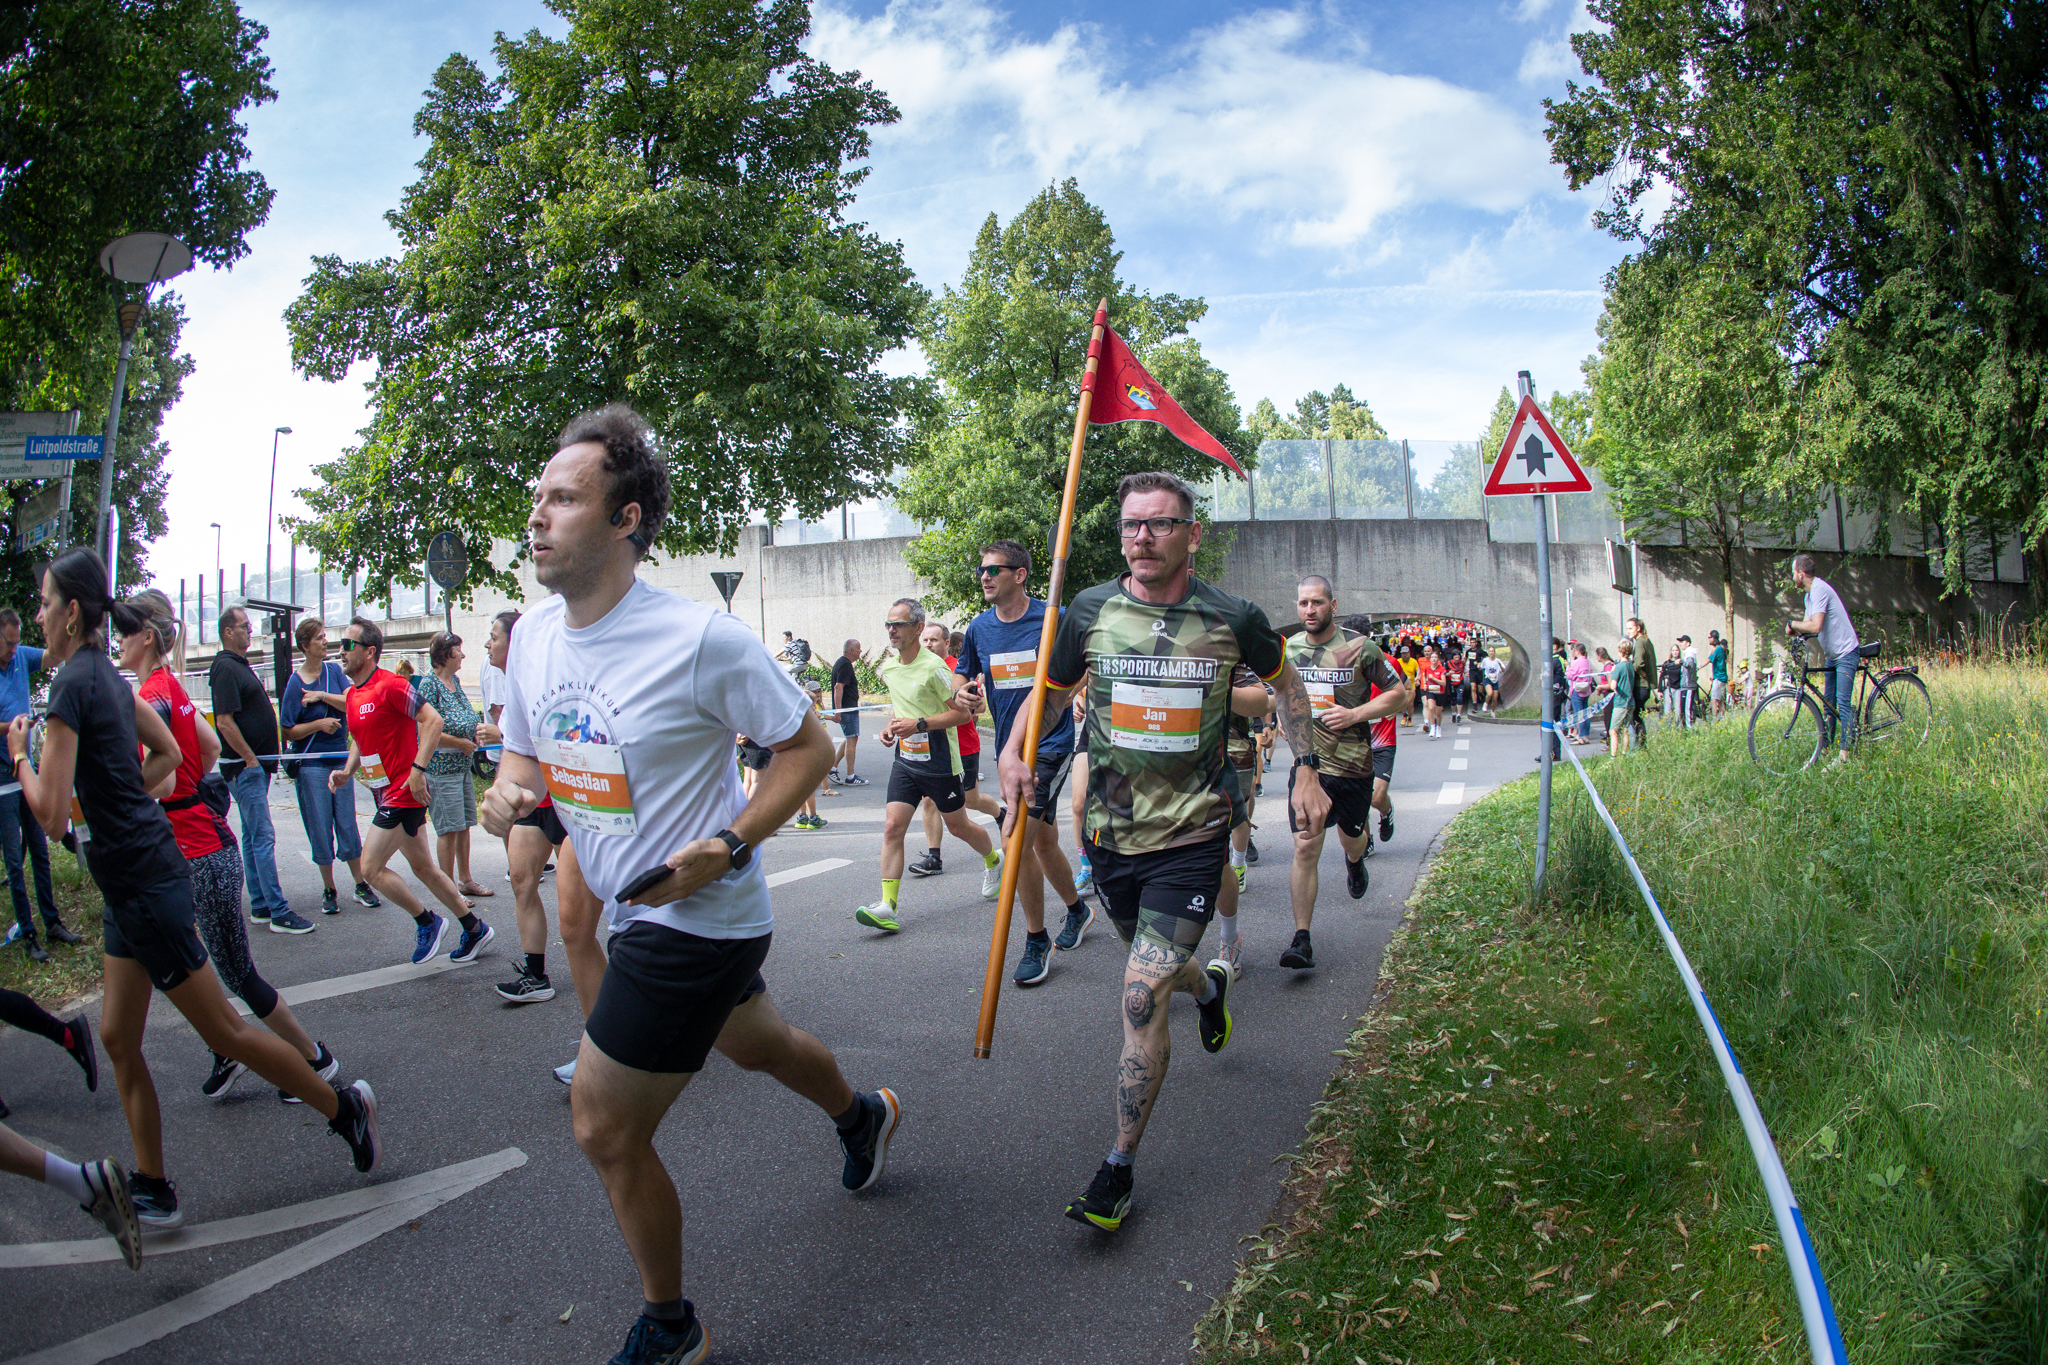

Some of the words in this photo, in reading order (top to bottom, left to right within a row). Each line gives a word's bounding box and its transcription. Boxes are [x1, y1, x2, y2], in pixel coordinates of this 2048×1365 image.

[30, 438, 99, 457] Luitpoldstraße
[1006, 664, 1019, 672] Ken
[1102, 659, 1213, 679] #SPORTKAMERAD
[532, 681, 621, 717] #TEAMKLINIKUM
[1142, 708, 1167, 721] Jan
[550, 765, 611, 793] Sebastian
